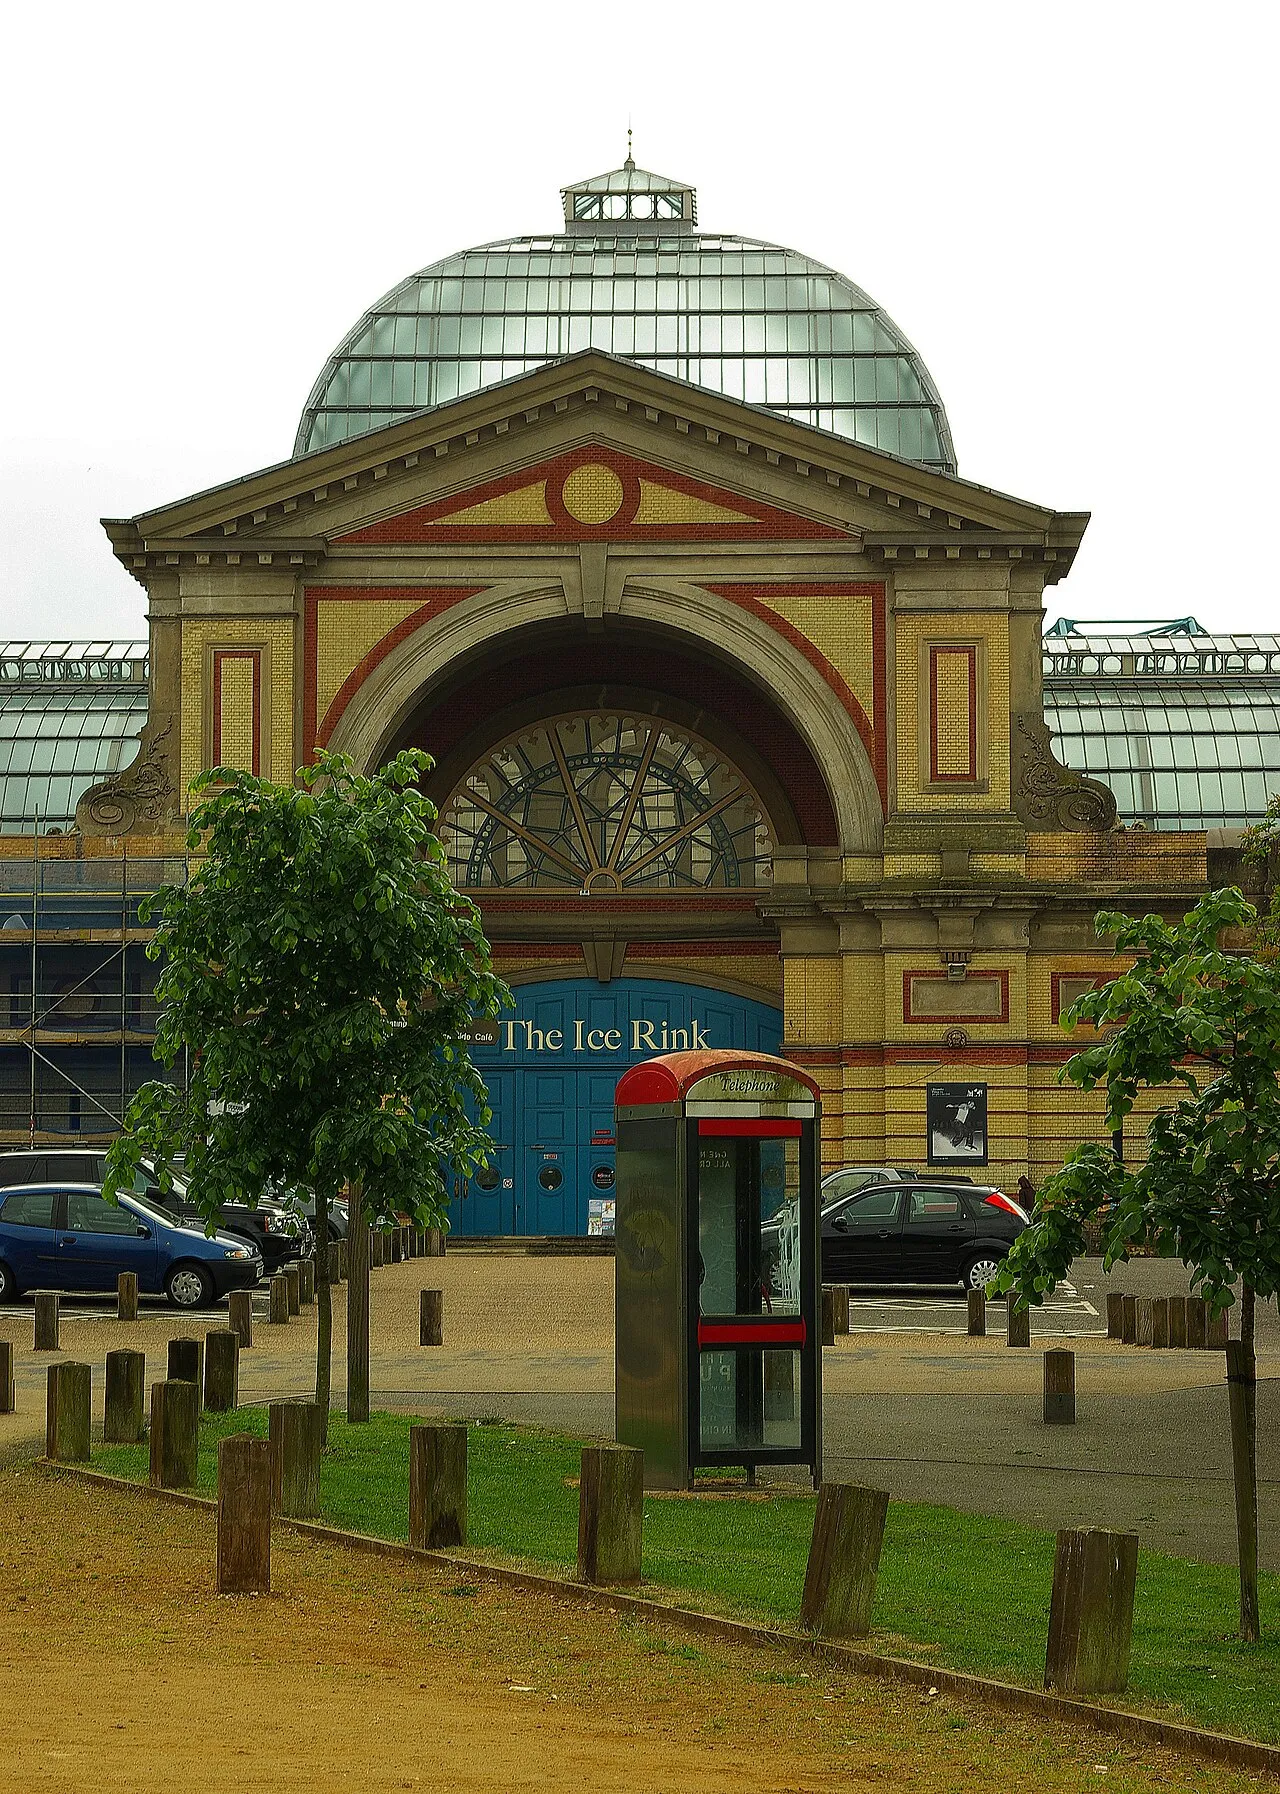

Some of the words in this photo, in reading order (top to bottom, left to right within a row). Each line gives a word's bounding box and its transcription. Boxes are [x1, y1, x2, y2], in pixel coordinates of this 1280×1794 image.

[498, 1020, 564, 1050] The
[573, 1020, 622, 1050] Ice
[630, 1019, 711, 1050] Rink
[720, 1078, 780, 1093] Telephone
